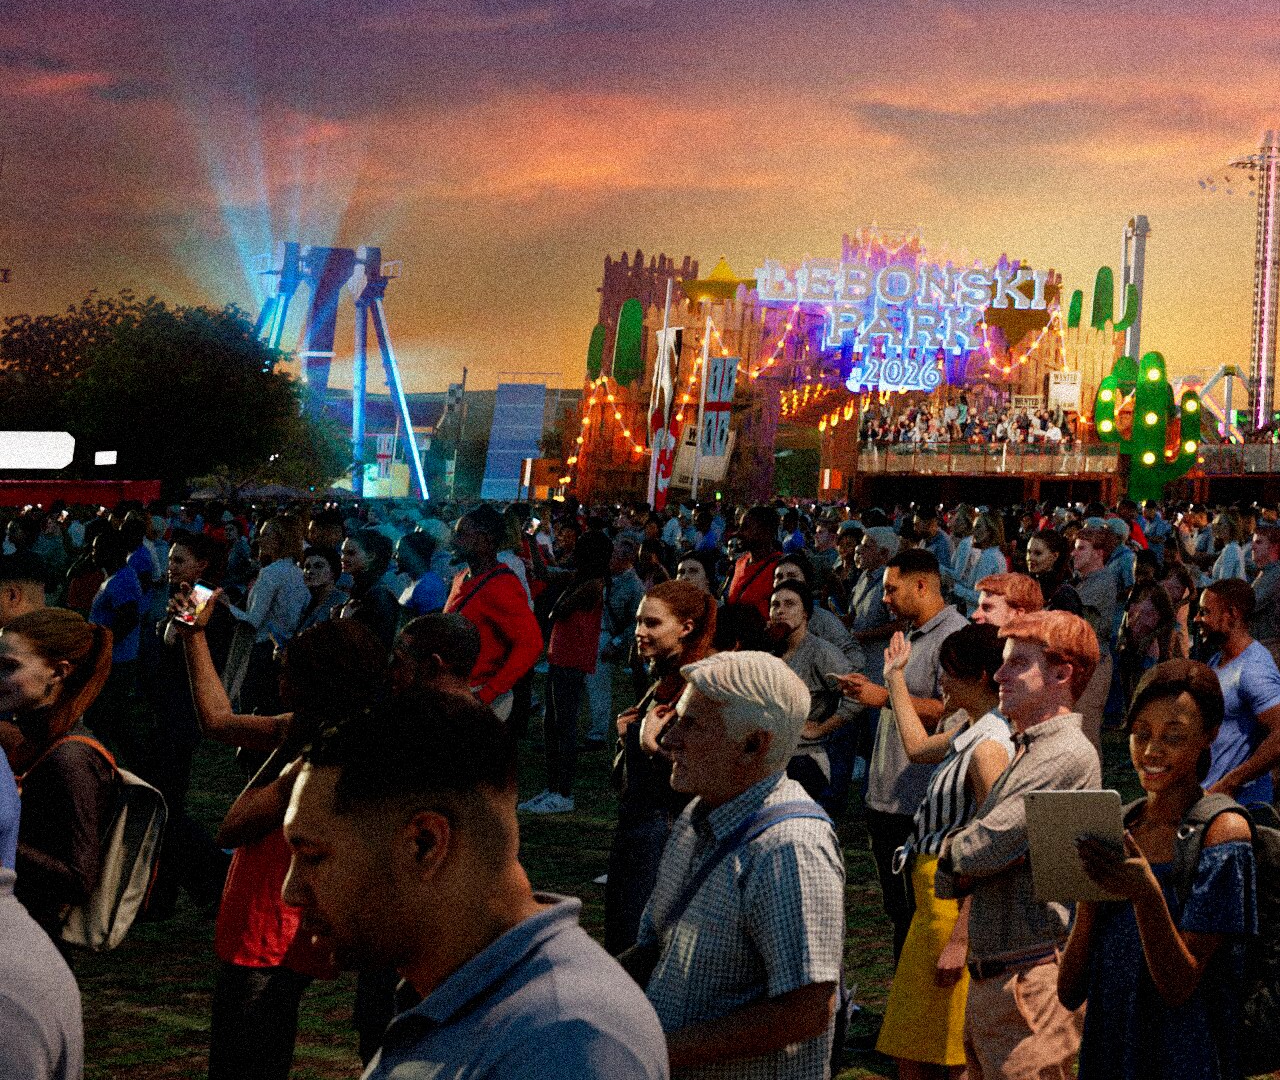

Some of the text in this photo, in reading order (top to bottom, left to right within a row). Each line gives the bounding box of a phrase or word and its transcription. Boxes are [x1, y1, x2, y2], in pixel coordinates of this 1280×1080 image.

[755, 257, 1049, 310] LEBONSKI
[826, 304, 982, 350] PARK
[865, 357, 942, 387] 2026
